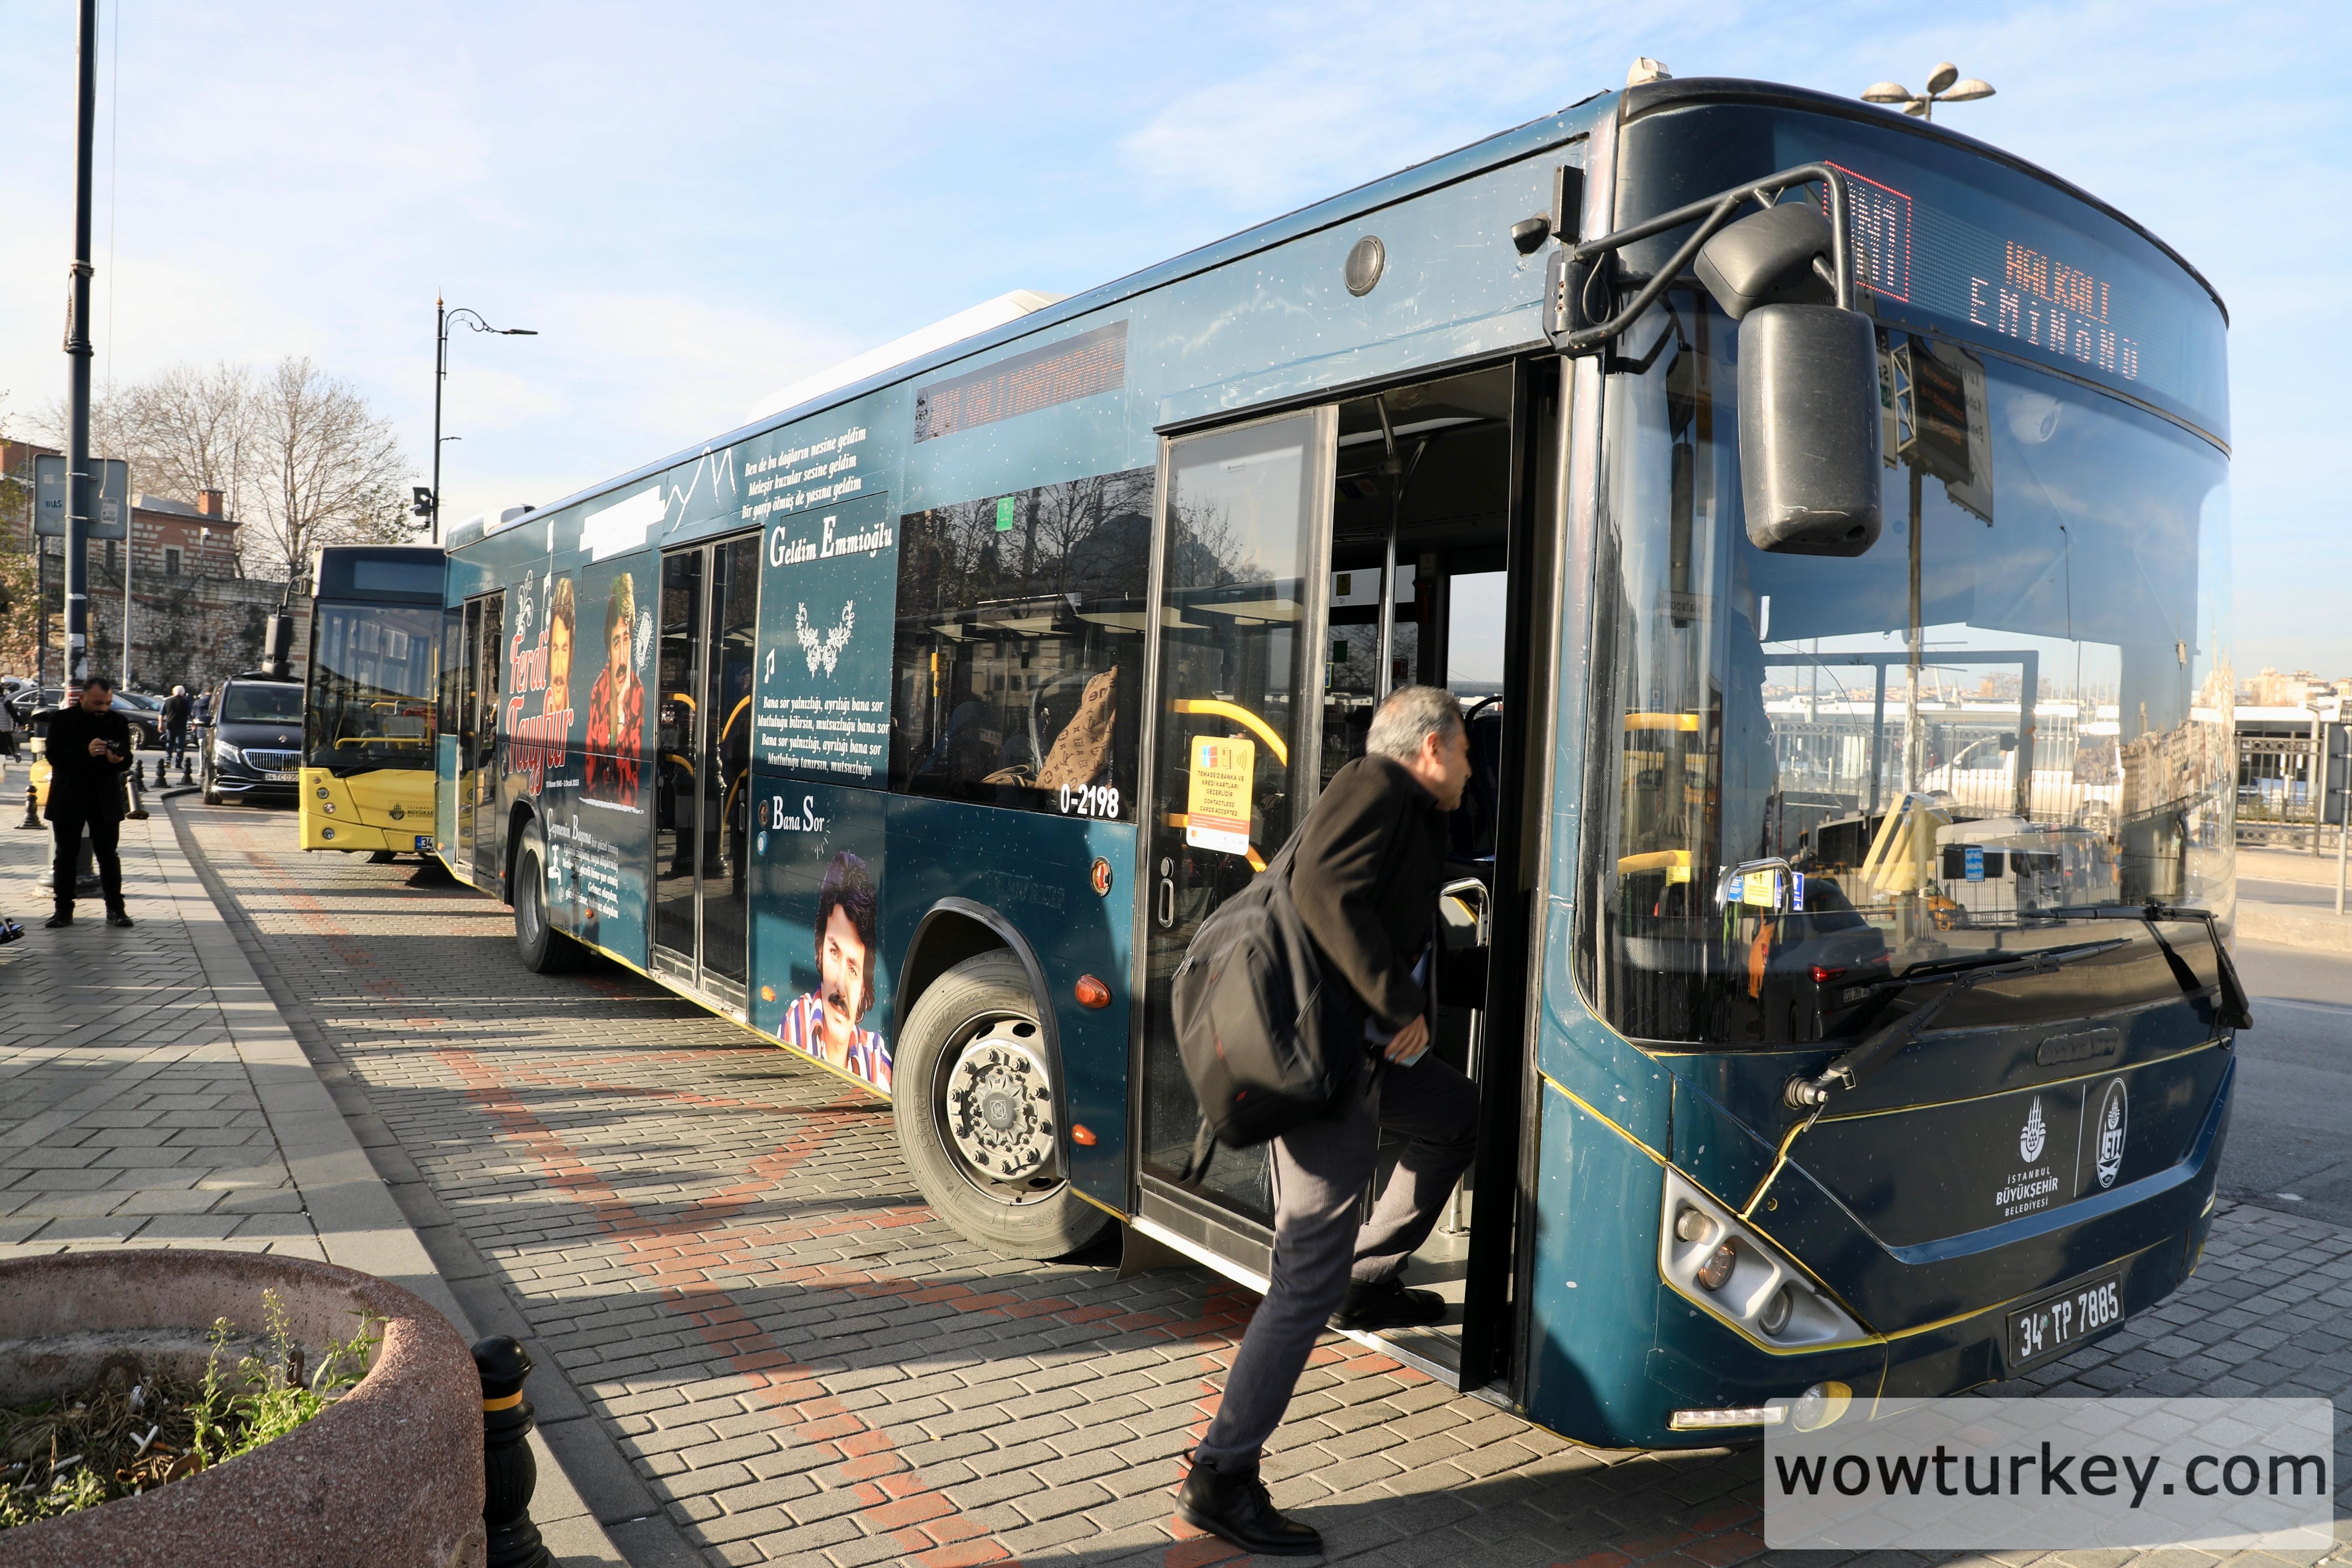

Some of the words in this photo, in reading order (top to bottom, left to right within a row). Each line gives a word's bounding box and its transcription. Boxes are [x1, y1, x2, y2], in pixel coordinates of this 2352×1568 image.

[2006, 240, 2109, 324] HALKALI
[1970, 277, 2137, 380] EMİNÖNÜ
[745, 463, 757, 477] Ben
[758, 457, 767, 473] de
[768, 455, 777, 470] bu
[778, 447, 809, 469] dağların
[811, 437, 837, 456] nesine
[837, 426, 866, 453] geldim
[748, 477, 774, 496] Meleşir
[774, 470, 803, 489] kuzular
[803, 462, 827, 481] sesine
[828, 453, 857, 479] geldim
[741, 504, 752, 519] Bir
[752, 499, 772, 521] garip
[773, 493, 794, 511] ölmüş
[795, 490, 804, 506] de
[805, 485, 832, 508] yasına
[832, 475, 861, 501] geldim
[770, 525, 817, 567] Geldim
[820, 515, 893, 558] Emmioğlu
[509, 628, 549, 694] Ferdi
[763, 696, 779, 708] Bana
[780, 699, 790, 709] sor
[790, 696, 823, 714] yalnızlığı,
[824, 696, 850, 715] ayrılığı
[852, 696, 870, 712] bana
[871, 701, 884, 712] sor
[506, 687, 574, 796] Tayfur
[757, 714, 788, 731] Mutluluğu
[789, 715, 814, 732] bilirsin,
[816, 717, 855, 736] mutsuzluğu
[857, 718, 876, 734] bana
[877, 723, 890, 734] sor
[761, 733, 777, 746] Bana
[778, 737, 789, 747] sor
[789, 735, 821, 754] yalnızlığı,
[823, 737, 848, 756] ayrılığı
[850, 739, 868, 754] bana
[869, 745, 882, 755] sor
[768, 752, 799, 771] Mutluluğu
[801, 756, 828, 773] tanırsın,
[831, 760, 872, 780] mutsuzluğu
[1060, 783, 1119, 818] 0-2198
[1204, 798, 1235, 808] CONTACTLESS
[1206, 789, 1233, 797] GEÇERLİDİR
[547, 808, 570, 840] Çeşmenin
[572, 815, 591, 846] Başına
[772, 796, 801, 831] Bana
[803, 795, 825, 832] Sor
[1215, 808, 1238, 816] ACCEPTED
[422, 838, 432, 848] 34
[1996, 1176, 2058, 1206] BÜYÜKŞEHİR
[2007, 1166, 2050, 1184] İSTANBUL
[2005, 1196, 2048, 1217] BELEDİYESİ
[2021, 1313, 2042, 1356] 34
[2052, 1301, 2072, 1343] TP
[2078, 1282, 2119, 1333] 7885
